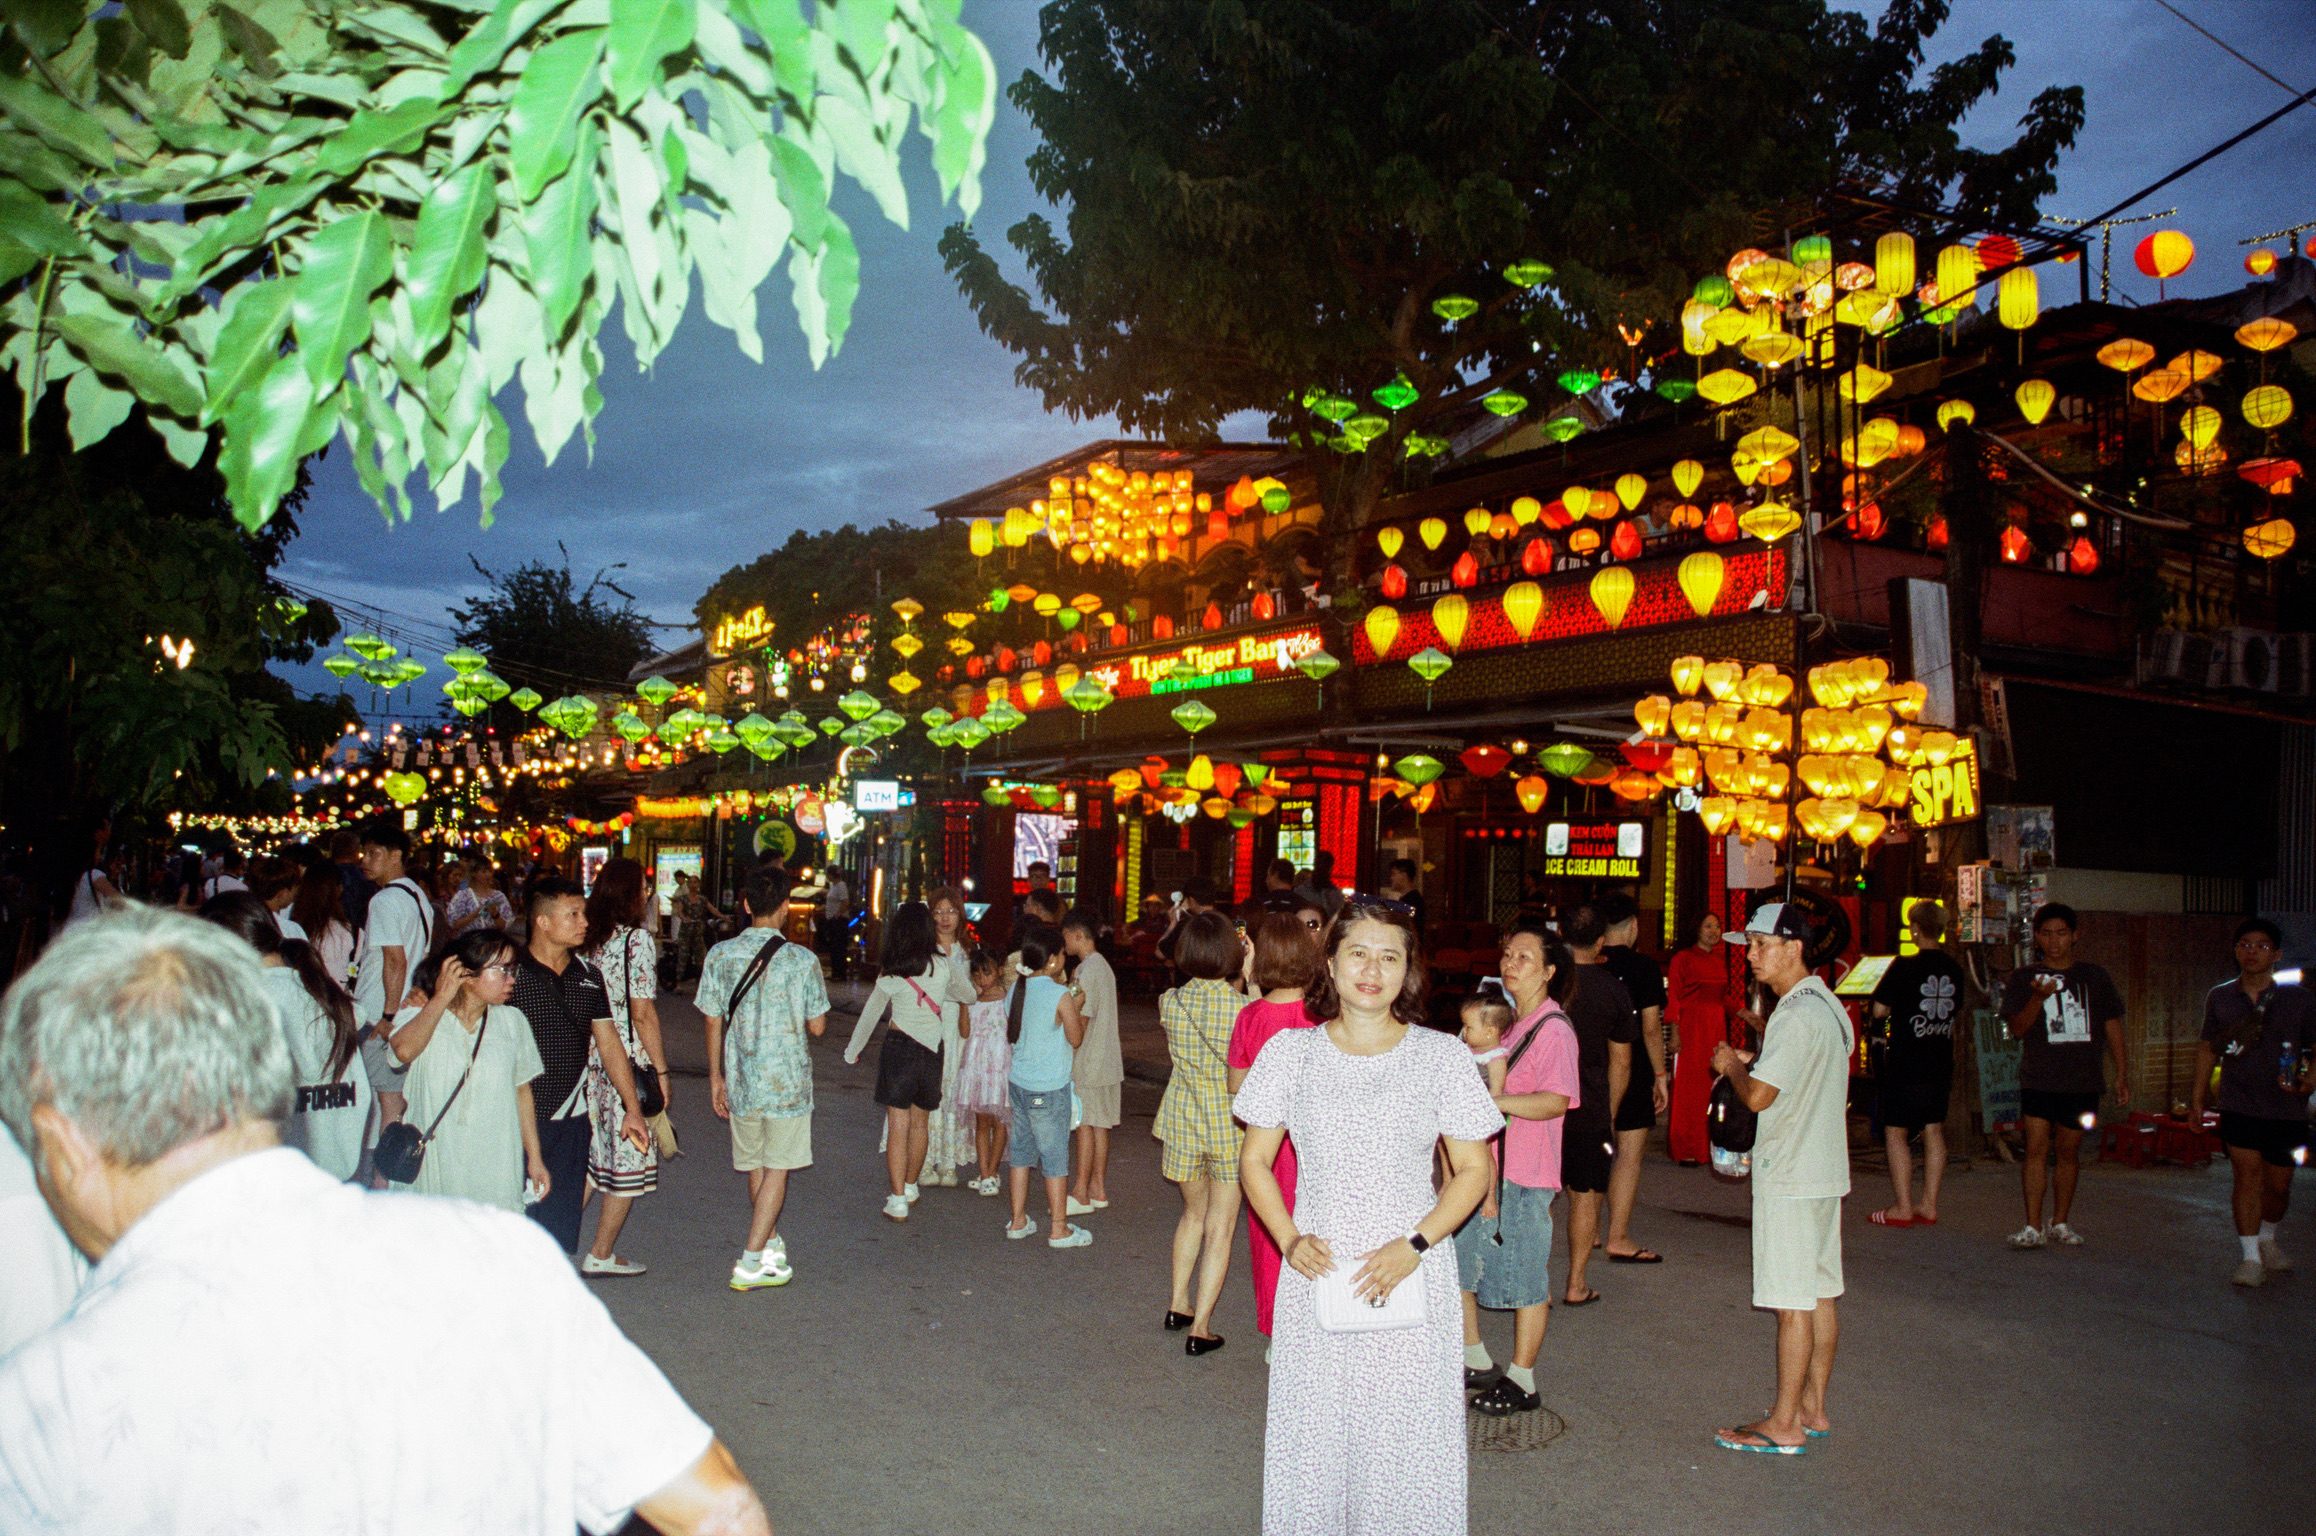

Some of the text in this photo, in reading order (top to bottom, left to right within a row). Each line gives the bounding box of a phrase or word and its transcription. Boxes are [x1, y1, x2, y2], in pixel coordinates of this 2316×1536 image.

[1129, 655, 1179, 682] Tiger
[1182, 646, 1236, 675] Tiger
[1239, 636, 1282, 664] Bar
[863, 792, 892, 803] ATM
[1911, 761, 1975, 824] SPA
[1594, 843, 1615, 856] LAN
[1566, 859, 1607, 875] CREAM
[1609, 859, 1640, 877] ROLL
